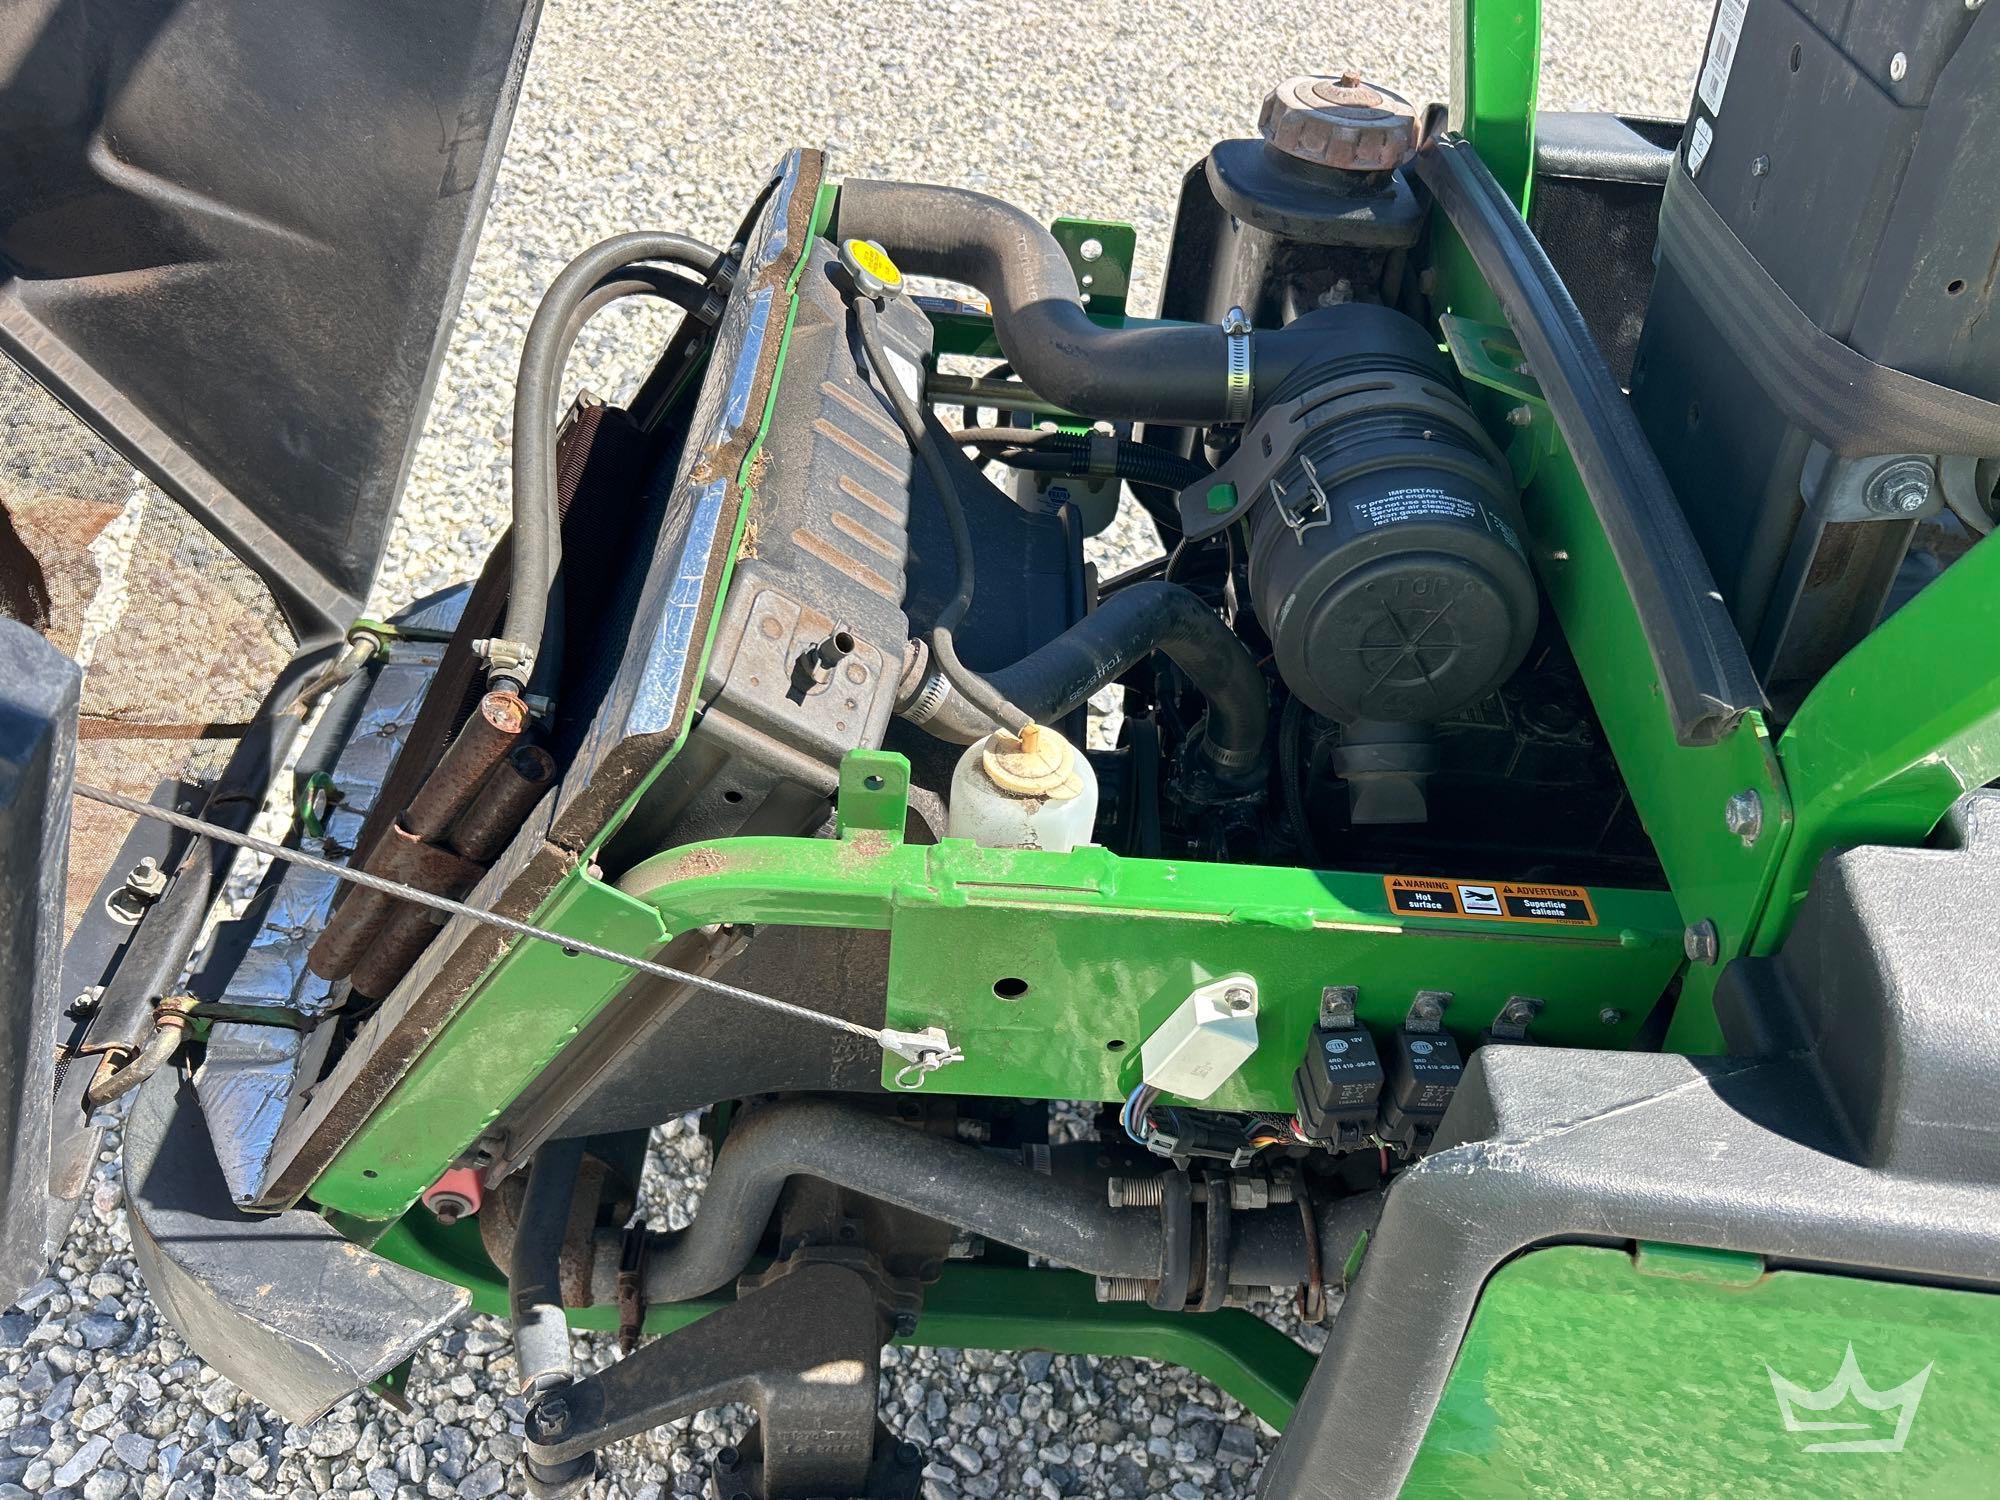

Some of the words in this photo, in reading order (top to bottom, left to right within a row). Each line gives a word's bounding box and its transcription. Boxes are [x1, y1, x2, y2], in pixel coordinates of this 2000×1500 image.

[1388, 488, 1445, 496] IMPORTANT
[1368, 495, 1404, 508] prevent
[1384, 502, 1401, 510] not
[1421, 500, 1456, 508] starting
[1371, 506, 1406, 517] Service
[1457, 508, 1475, 517] only
[1372, 512, 1397, 522] when
[1399, 509, 1429, 517] gauge
[1430, 509, 1466, 518] reaches
[1392, 576, 1450, 597] TOP
[1403, 879, 1449, 890] WARNING
[1516, 886, 1579, 897] ADVERTENCIA
[1416, 893, 1432, 901] Hot
[1408, 901, 1443, 910] surface
[1523, 900, 1567, 910] Superficie
[1531, 908, 1566, 917] caliente
